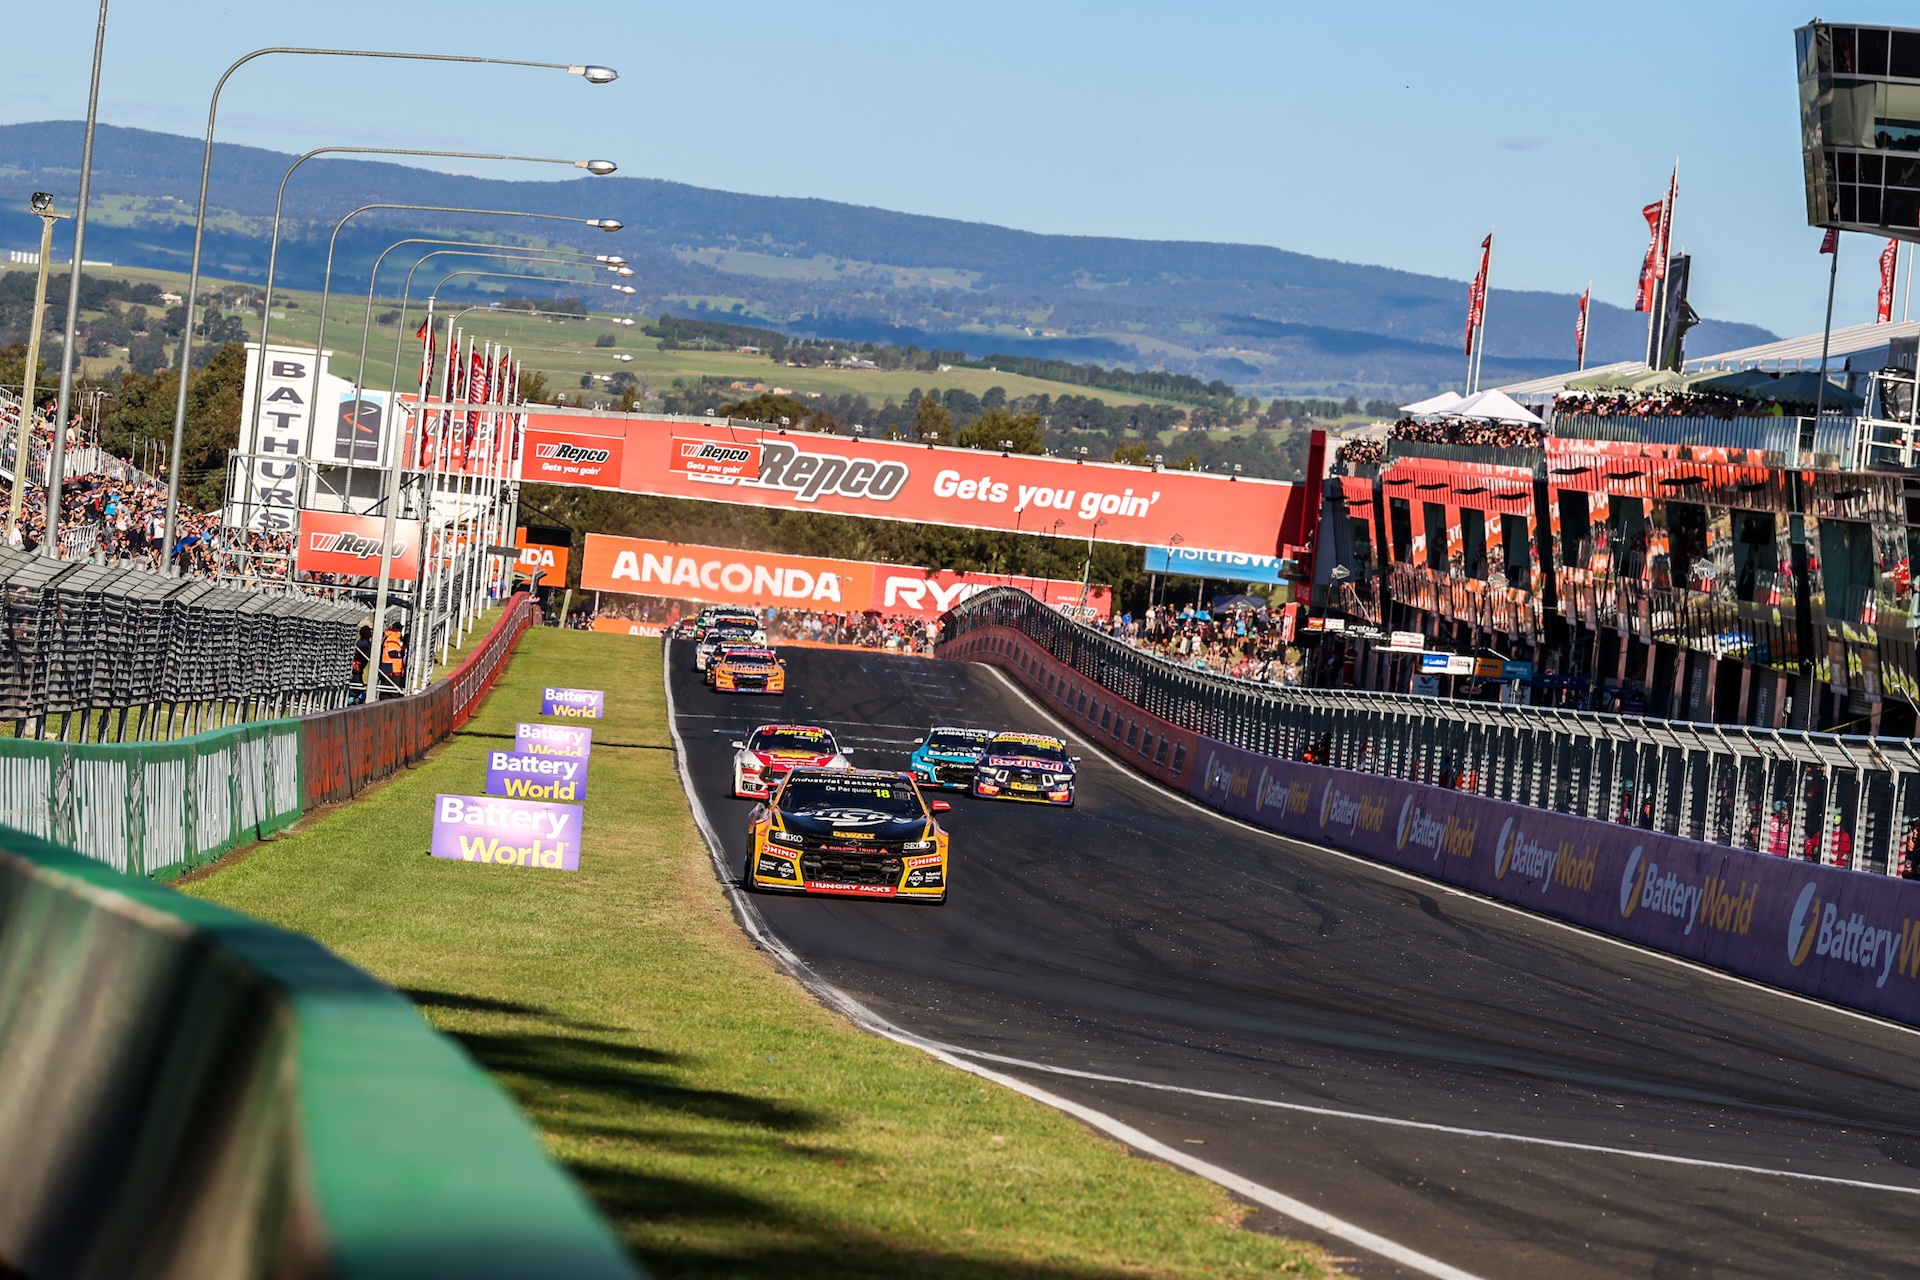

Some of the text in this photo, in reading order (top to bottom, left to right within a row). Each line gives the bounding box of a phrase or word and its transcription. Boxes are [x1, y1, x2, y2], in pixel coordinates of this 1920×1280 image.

[555, 443, 609, 463] Repco
[699, 443, 750, 462] Repco
[541, 462, 601, 476] Gets you goin'
[686, 461, 742, 475] Gets you goin'
[758, 440, 1160, 520] Repco Gets you goin'
[611, 550, 841, 603] ANACONDA
[545, 688, 599, 706] Battery
[552, 704, 597, 718] World
[519, 724, 585, 746] Battery
[491, 753, 579, 780] Battery
[989, 757, 1064, 773] Red Bull
[504, 778, 576, 800] World
[844, 780, 892, 788] Batteries
[872, 789, 890, 798] 18
[440, 797, 570, 839] Battery
[458, 835, 564, 869] World
[811, 882, 857, 890] HUNGRY
